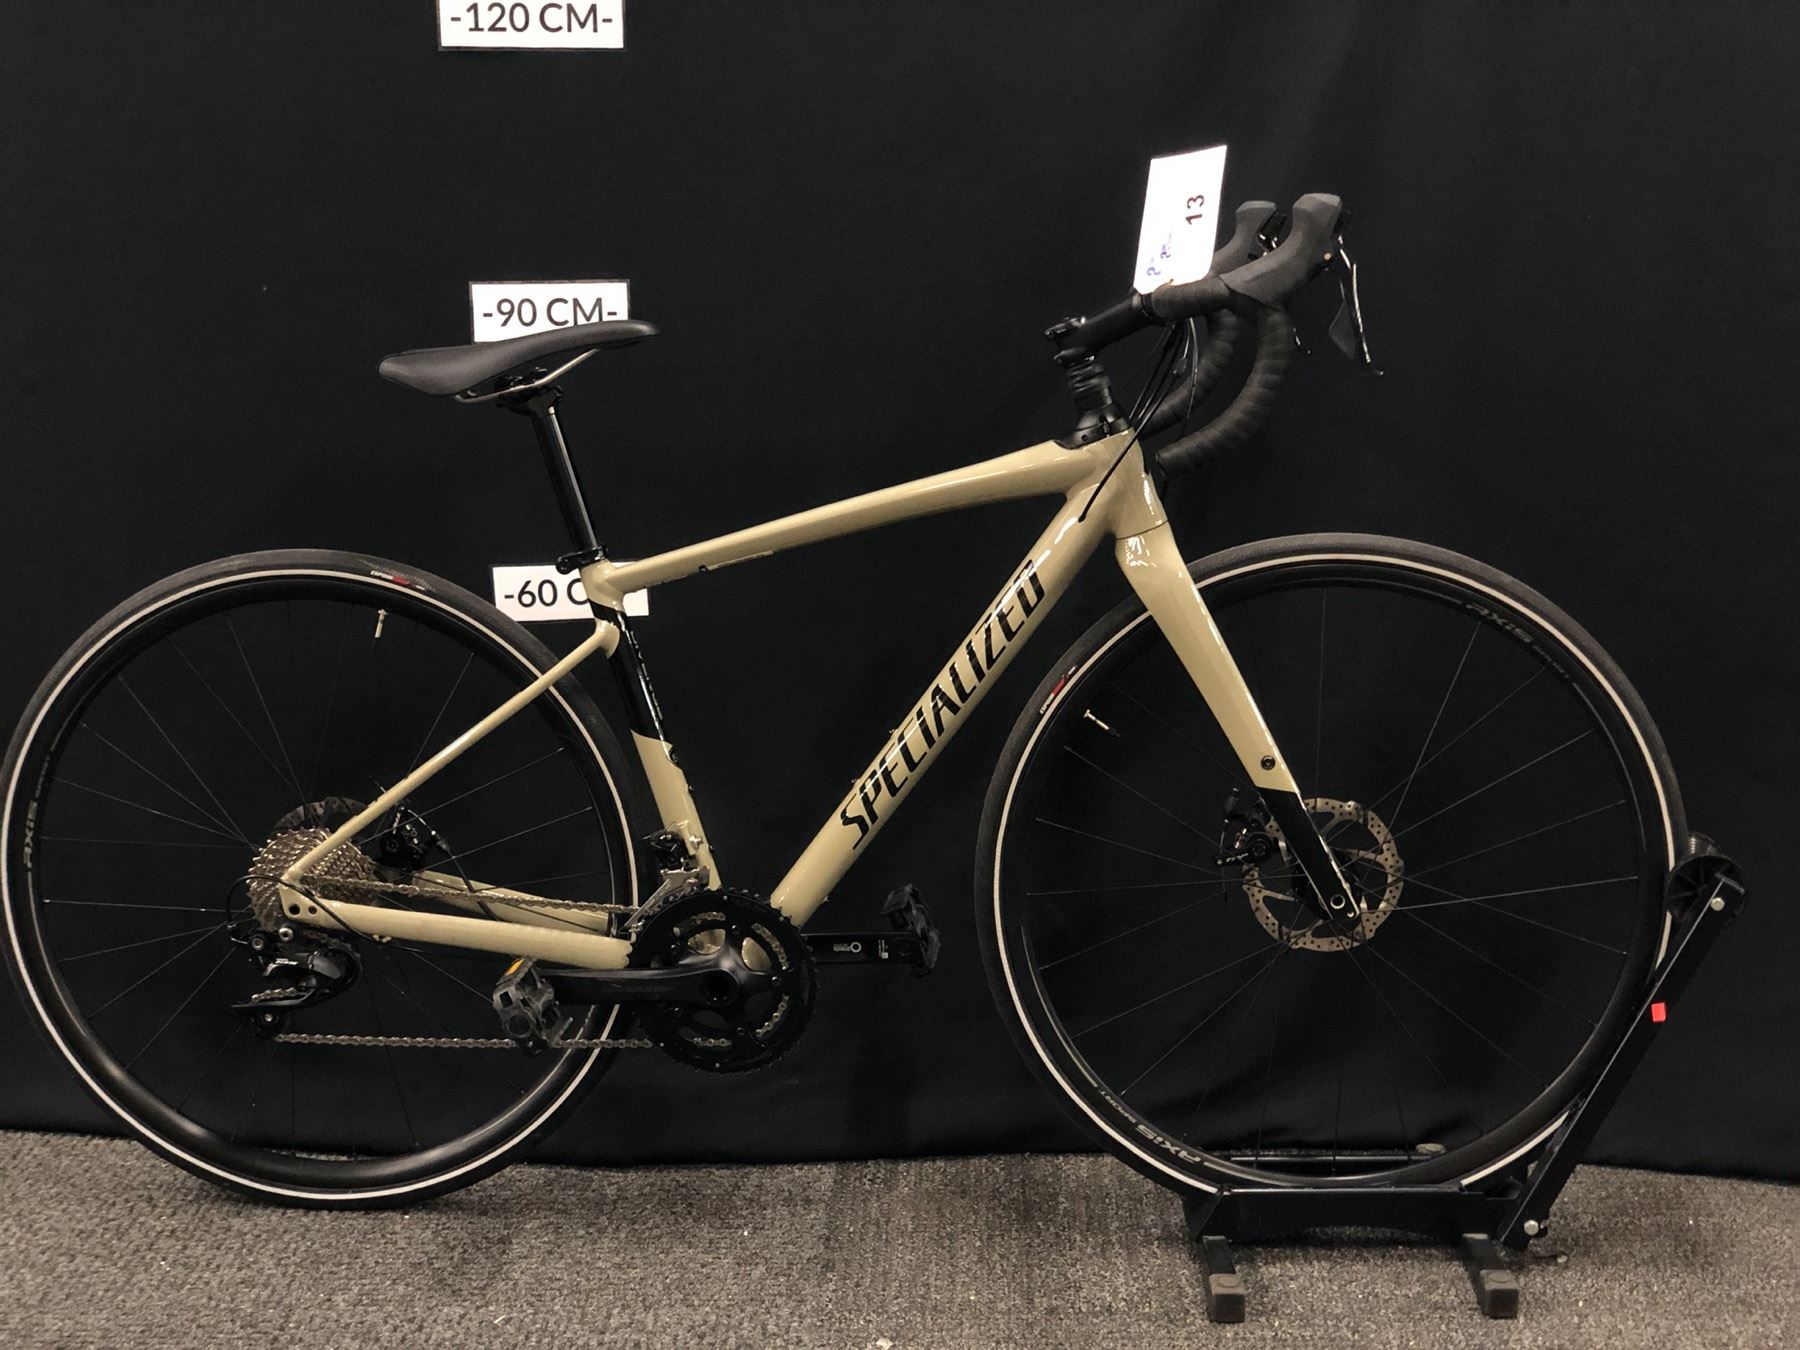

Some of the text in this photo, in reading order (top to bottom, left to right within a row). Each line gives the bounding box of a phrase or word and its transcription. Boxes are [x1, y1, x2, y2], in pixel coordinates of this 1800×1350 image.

[451, 3, 612, 32] -120 CM-
[1185, 194, 1205, 225] 13
[483, 297, 618, 327] -90 CM-
[504, 579, 558, 608] -60
[840, 559, 1046, 850] SPECIALIZED
